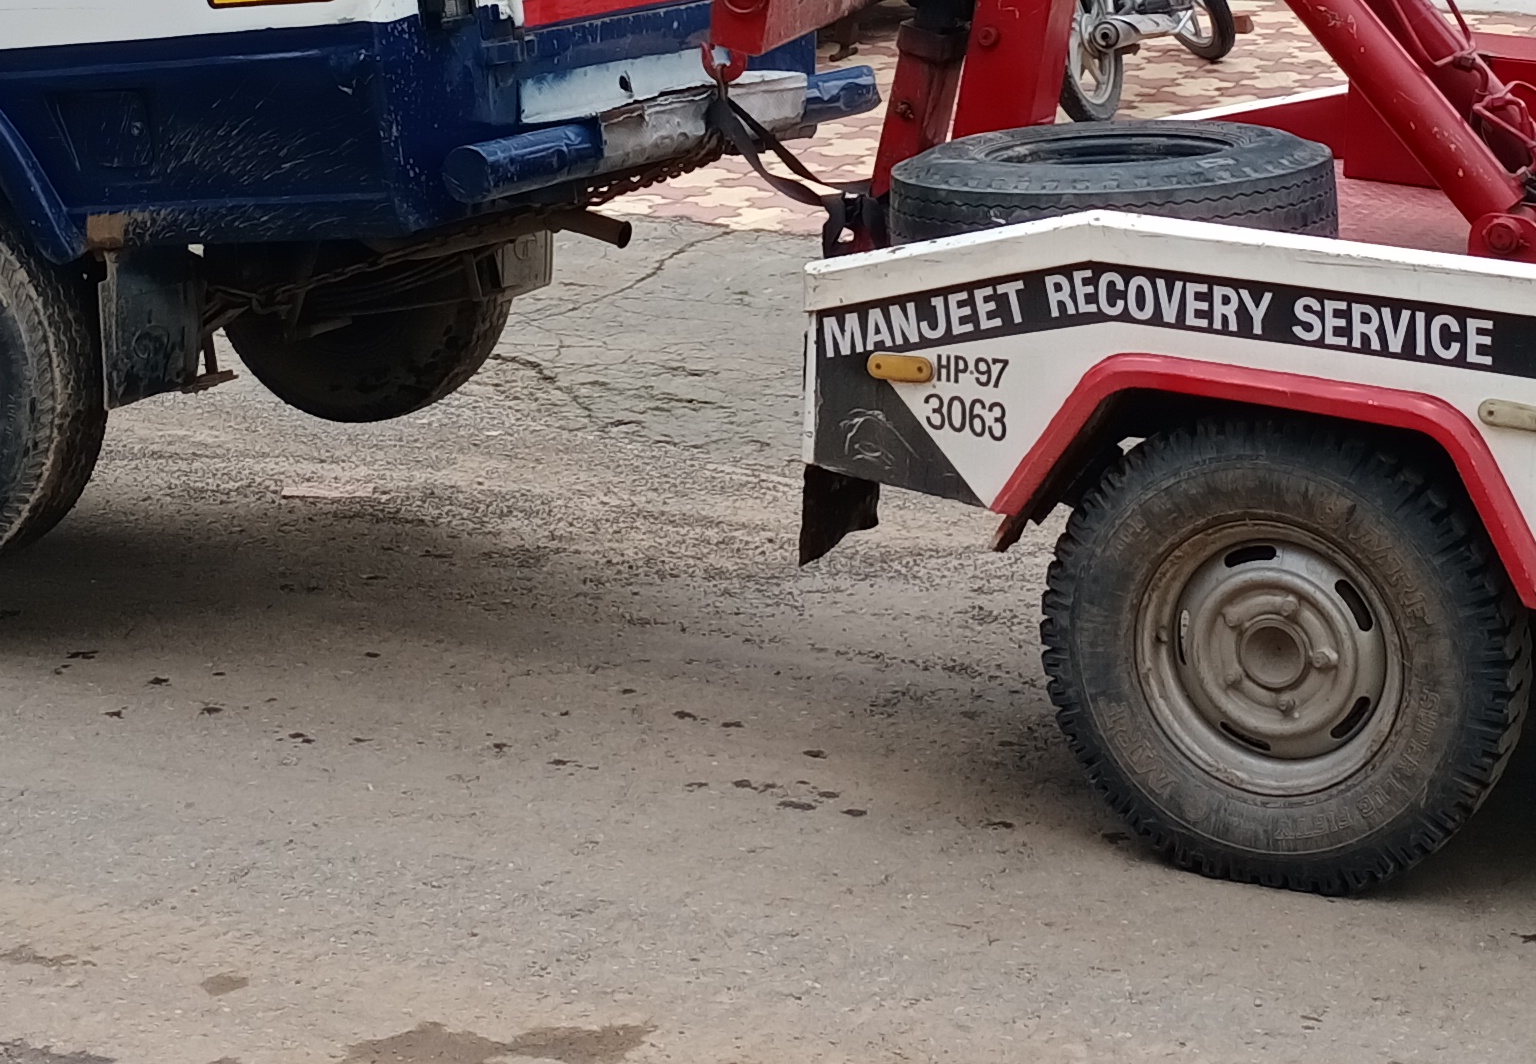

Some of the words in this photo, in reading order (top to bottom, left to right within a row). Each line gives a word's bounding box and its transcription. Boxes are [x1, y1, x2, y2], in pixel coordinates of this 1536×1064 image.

[823, 280, 1024, 357] MANJEET
[1047, 269, 1274, 335] RECOVERY
[1292, 296, 1496, 366] SERVICE
[924, 393, 1007, 441] 3063
